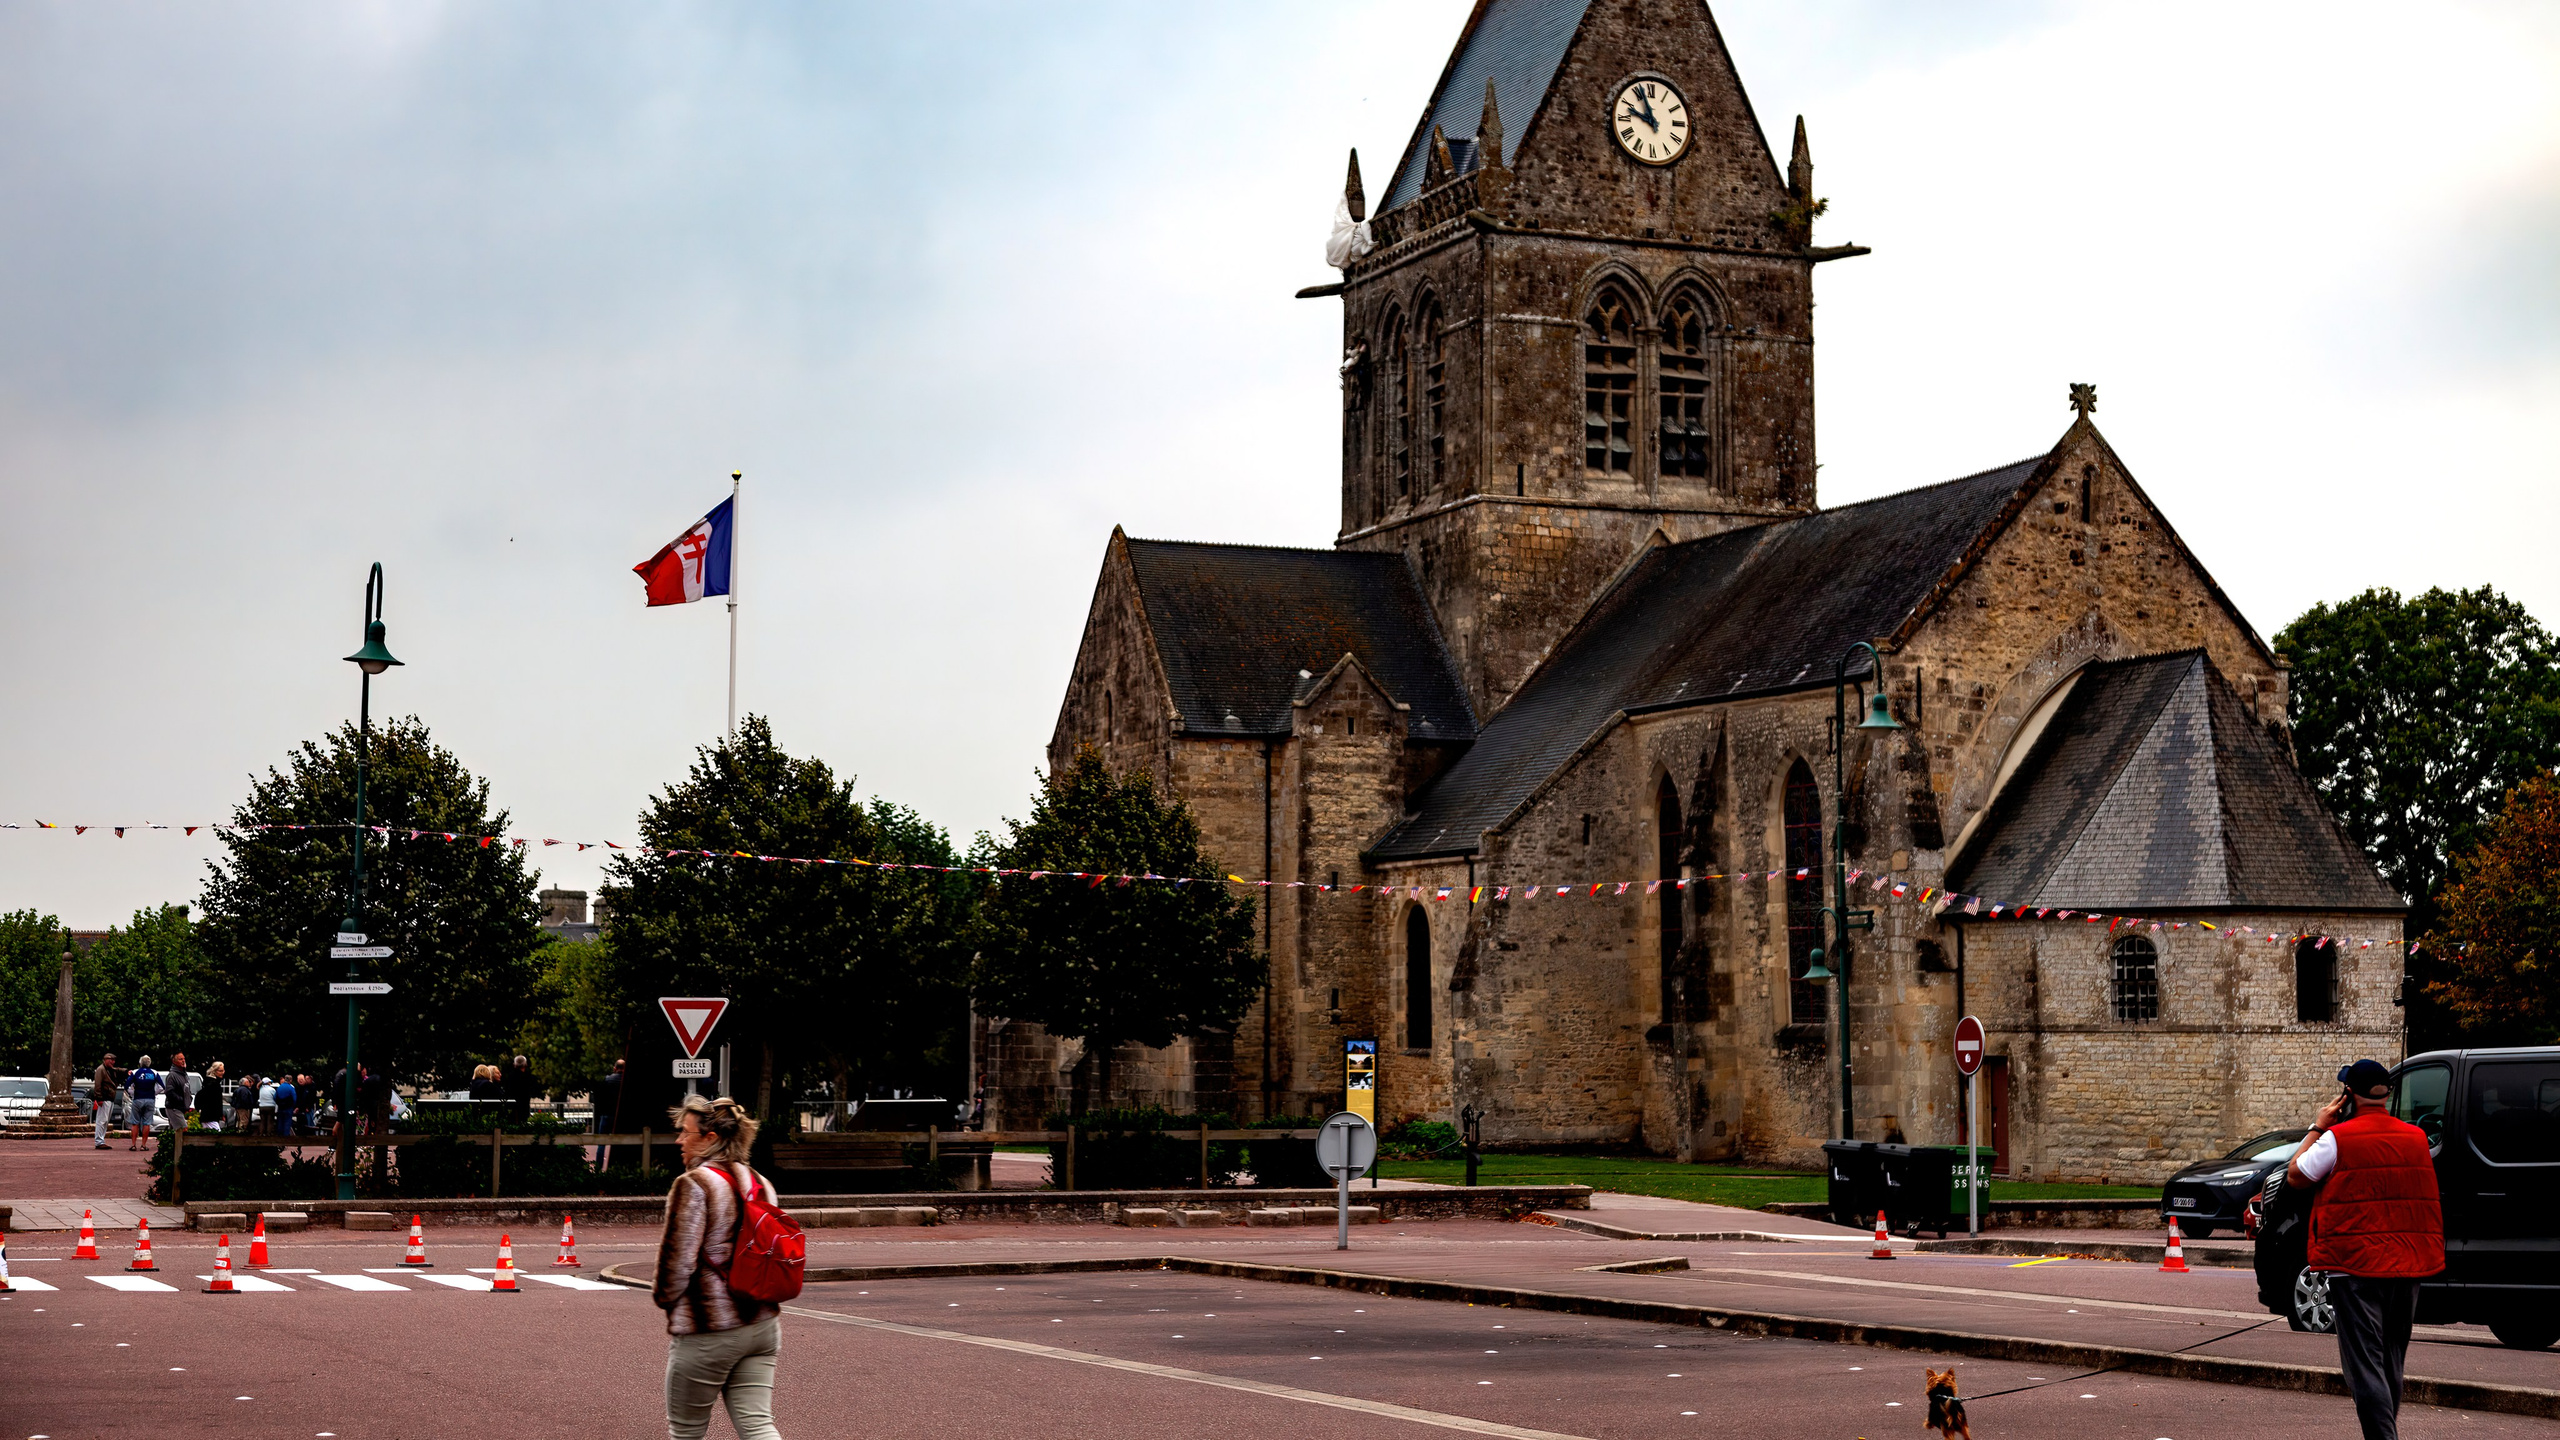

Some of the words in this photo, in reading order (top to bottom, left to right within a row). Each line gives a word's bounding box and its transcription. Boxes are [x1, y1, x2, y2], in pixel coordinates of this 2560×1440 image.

[1660, 90, 1669, 103] I
[1662, 142, 1671, 156] V
[1954, 1179, 1990, 1189] SSNS
